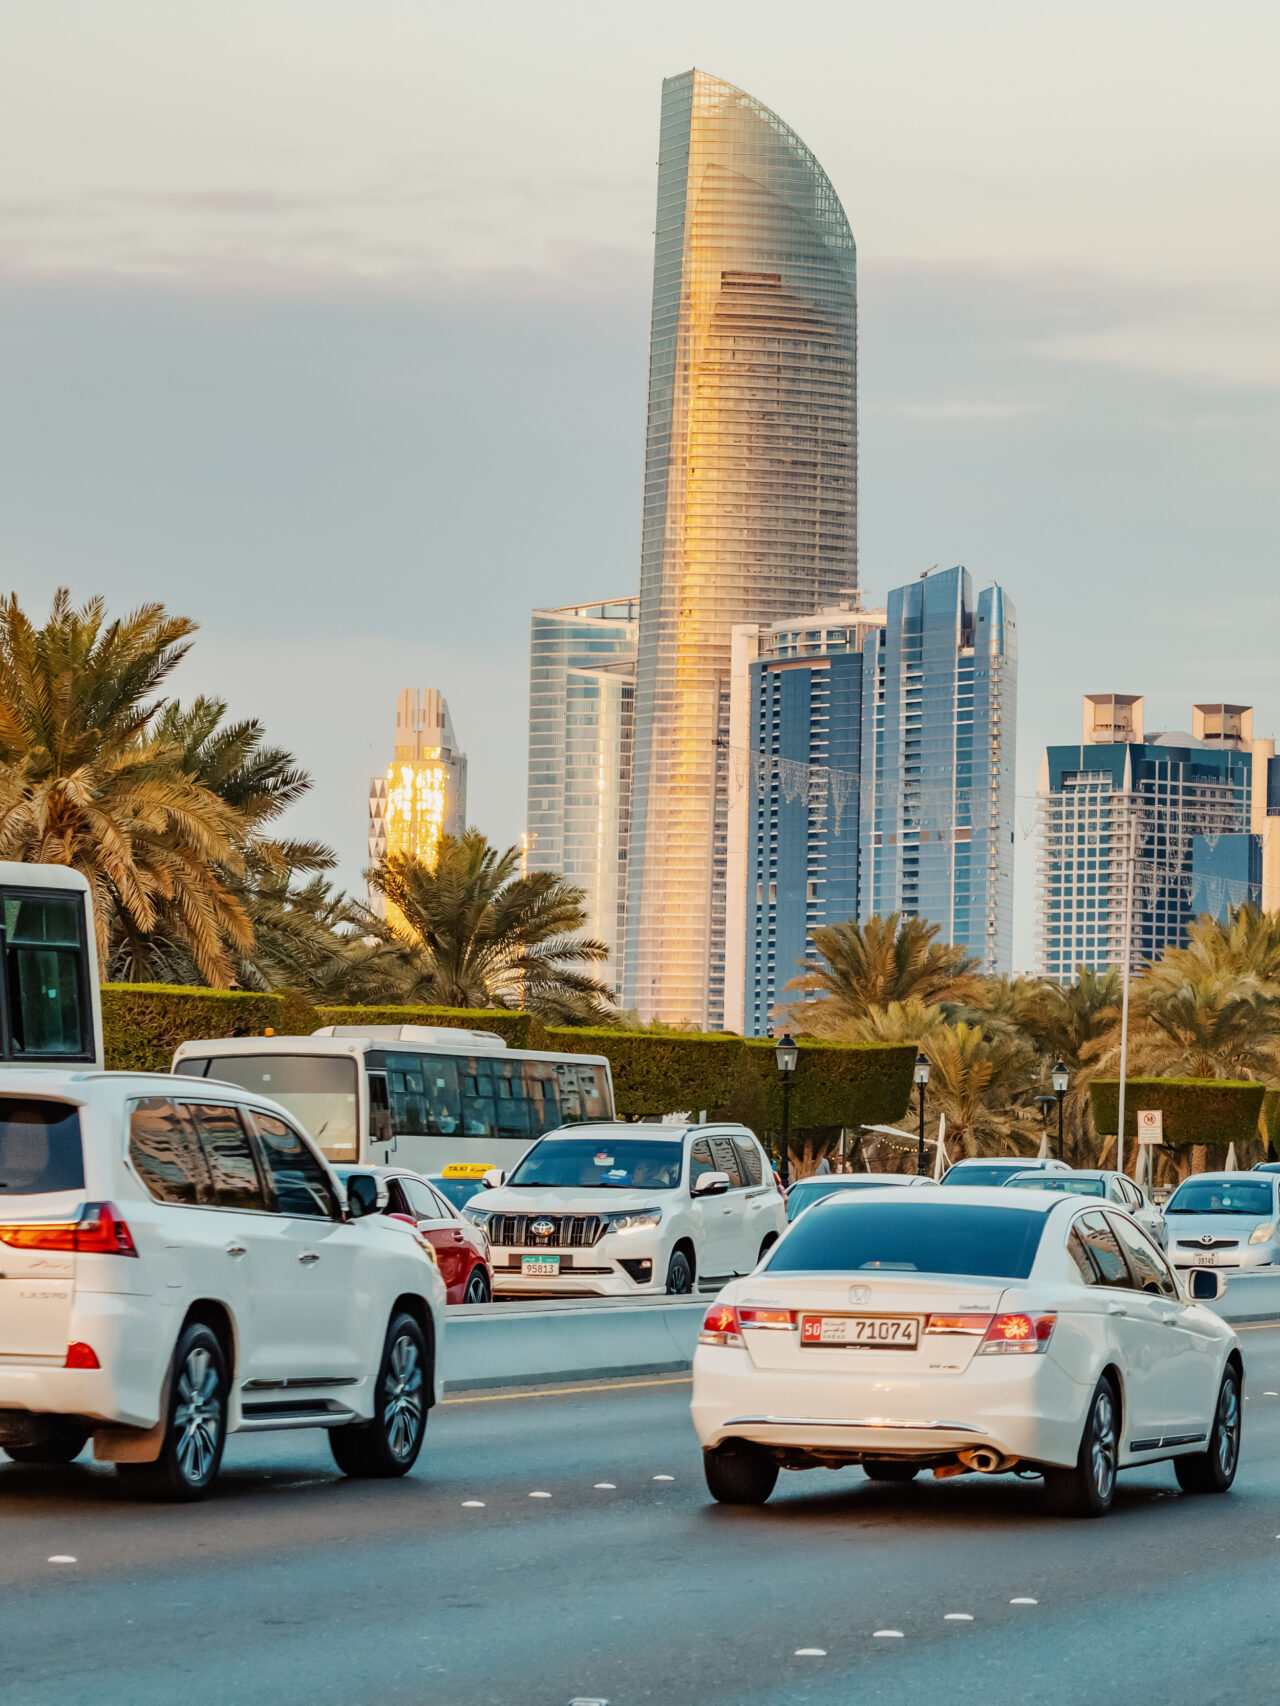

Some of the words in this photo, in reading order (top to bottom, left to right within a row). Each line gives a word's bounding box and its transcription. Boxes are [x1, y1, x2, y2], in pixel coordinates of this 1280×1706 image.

[527, 1264, 554, 1274] 95813
[804, 1322, 820, 1336] 50
[855, 1321, 912, 1341] 71074
